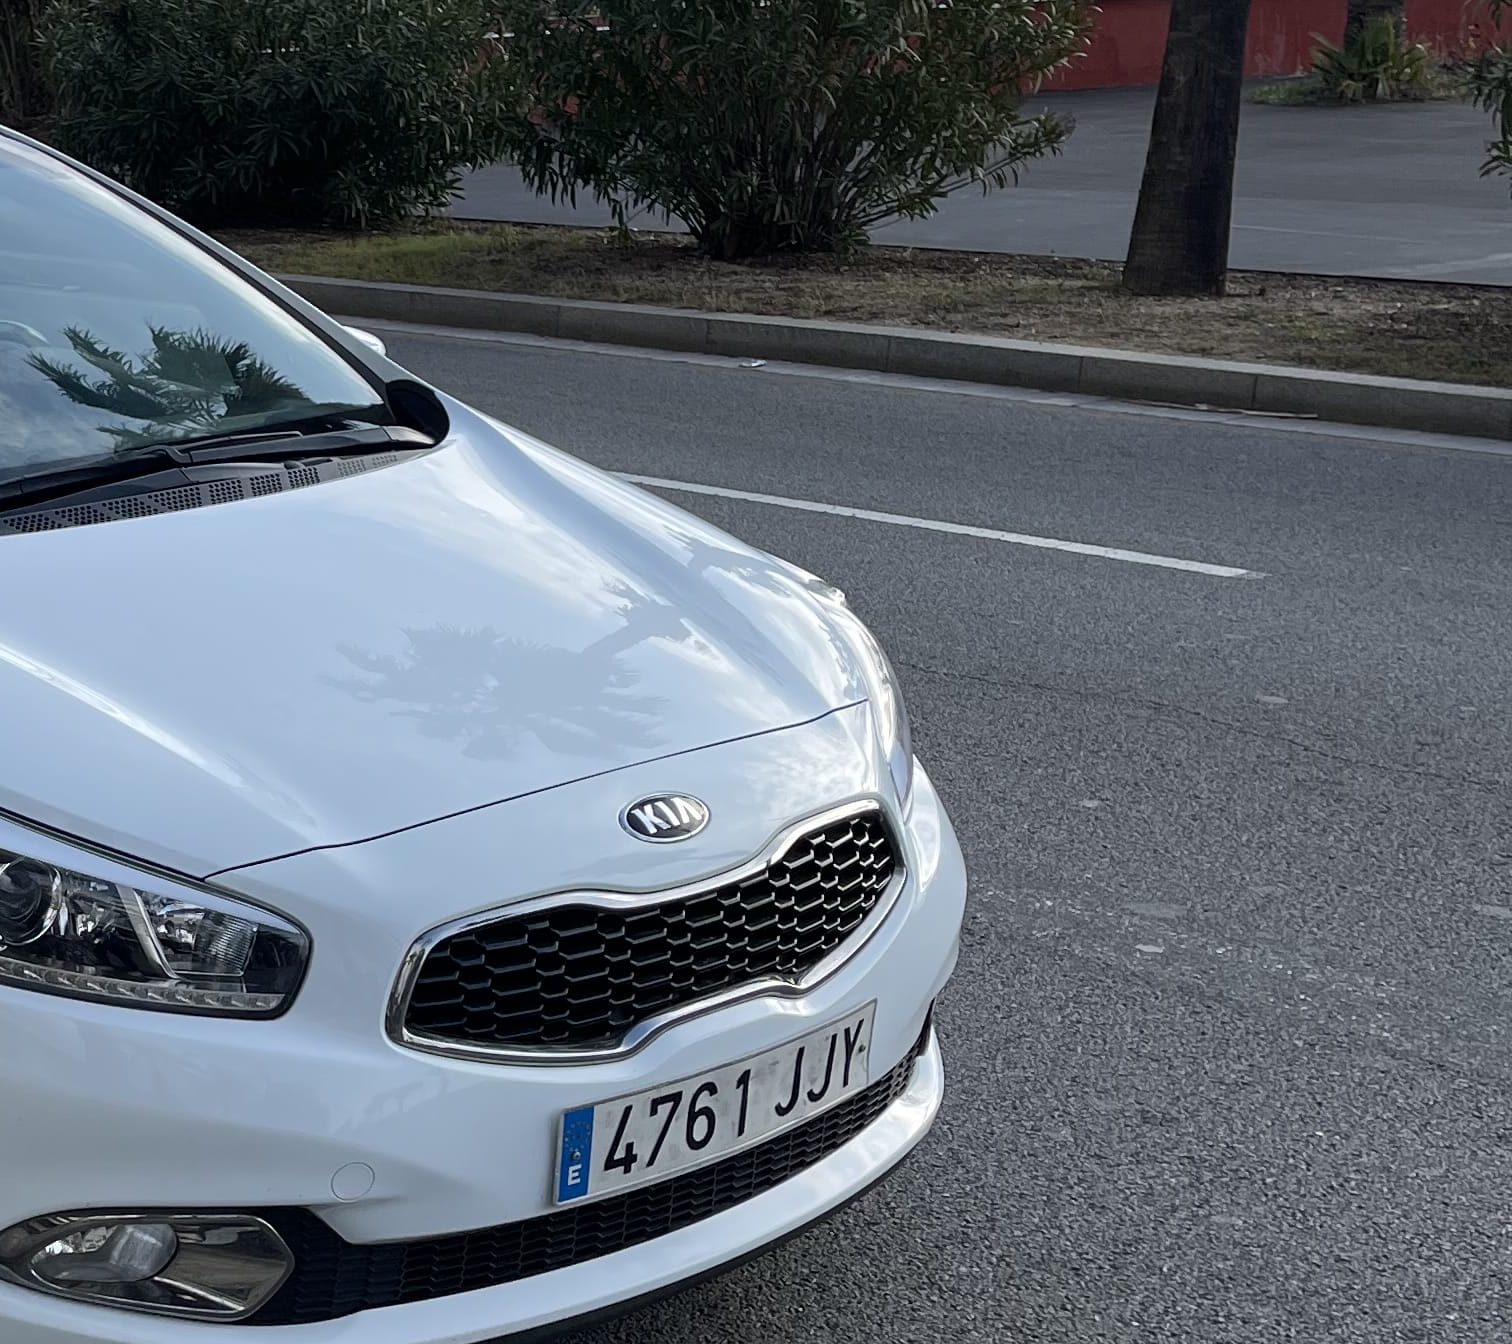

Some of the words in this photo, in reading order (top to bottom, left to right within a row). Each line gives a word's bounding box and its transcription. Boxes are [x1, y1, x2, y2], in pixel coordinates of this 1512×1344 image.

[630, 797, 703, 834] KIA
[603, 1068, 751, 1175] 4761
[775, 1018, 865, 1117] JJY
[567, 1164, 581, 1186] E
